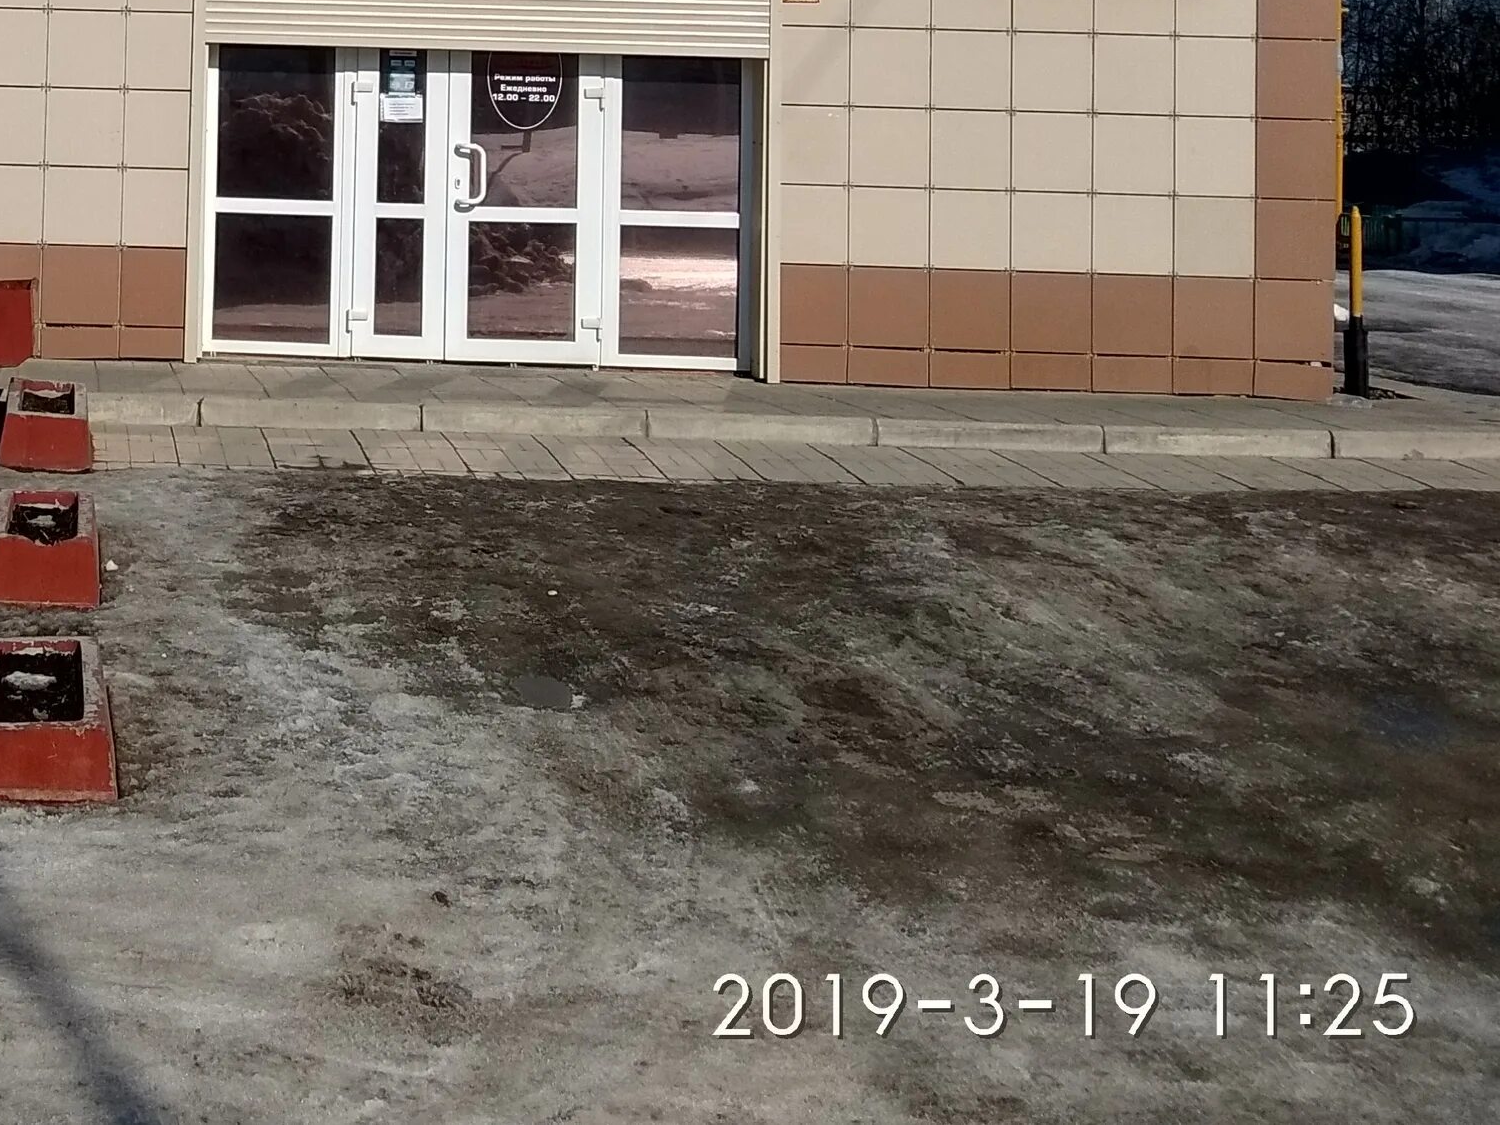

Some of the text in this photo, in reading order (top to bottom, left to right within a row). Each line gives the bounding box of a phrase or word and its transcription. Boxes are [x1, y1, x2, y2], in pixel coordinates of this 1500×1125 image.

[494, 73, 523, 81] Режим
[500, 83, 547, 93] Ежедневно
[492, 93, 519, 101] 12.00
[528, 94, 555, 102] 22.00
